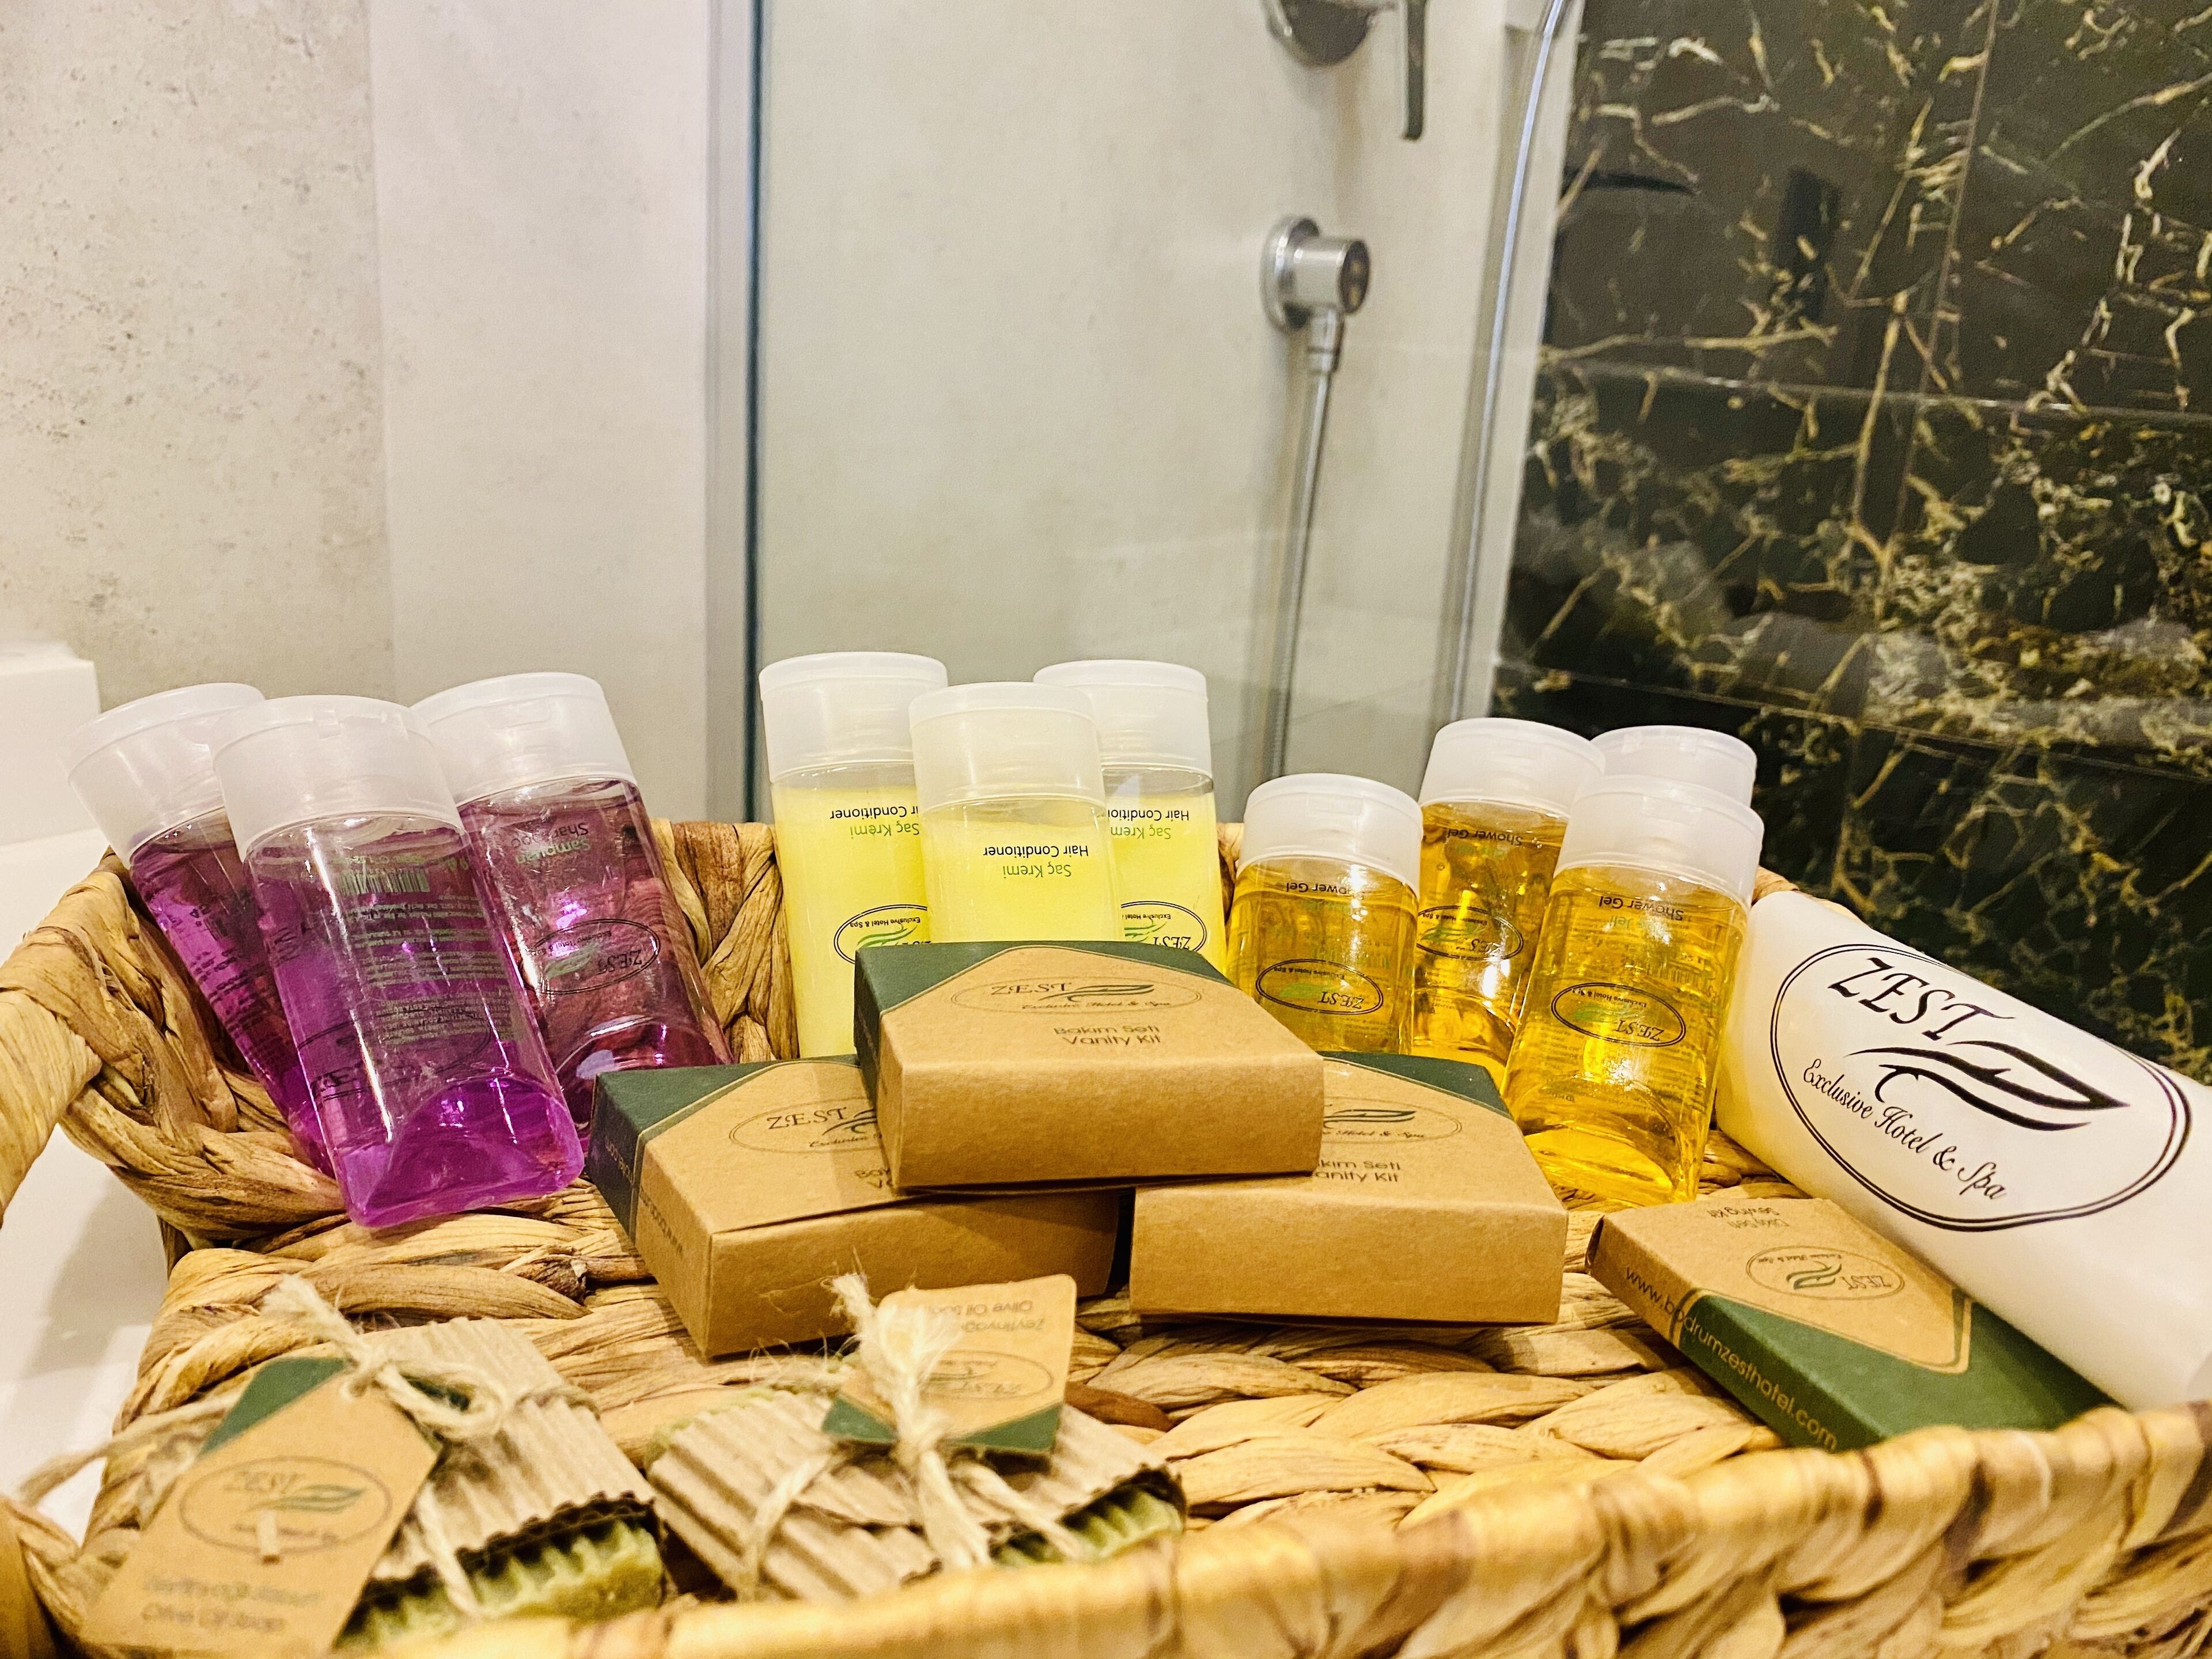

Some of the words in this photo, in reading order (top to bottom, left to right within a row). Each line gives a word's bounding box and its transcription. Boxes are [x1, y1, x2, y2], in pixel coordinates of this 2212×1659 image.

[830, 806, 907, 820] Conditioner
[1108, 809, 1162, 821] Conditio
[1165, 810, 1189, 821] Hair
[850, 824, 891, 839] Kremi
[897, 820, 920, 835] Saç
[1111, 826, 1145, 839] Krem
[1149, 824, 1171, 839] Saç
[1447, 828, 1469, 839] Gel
[1471, 830, 1522, 846] Shower
[983, 845, 1059, 858] Conditioner
[1063, 845, 1089, 857] Hair
[1003, 865, 1043, 879] Kremi
[1047, 861, 1071, 877] Saç
[1286, 882, 1308, 892] Gel
[1599, 896, 1623, 908] Gel
[1627, 900, 1684, 922] Shower
[991, 982, 1072, 995] ZEST
[1318, 991, 1364, 1009] ZEST
[1827, 957, 2016, 1041] ZEST
[1615, 1020, 1664, 1041] ZEST
[1062, 1035, 1130, 1046] Vanity
[1137, 1035, 1161, 1044] Kit
[766, 1107, 847, 1130] ZEST
[1802, 1058, 1873, 1119] Exclusive
[1874, 1106, 1944, 1154] Hotel
[1932, 1145, 1957, 1171] &
[1957, 1162, 2008, 1200] Spa
[1315, 1171, 1368, 1182] anity
[1374, 1172, 1399, 1182] Kit
[1842, 1275, 1892, 1291] ZEST
[965, 1304, 987, 1316] Oil
[992, 1300, 1033, 1313] Olive
[1626, 1267, 1839, 1451] www.bodrumzesthotel.com
